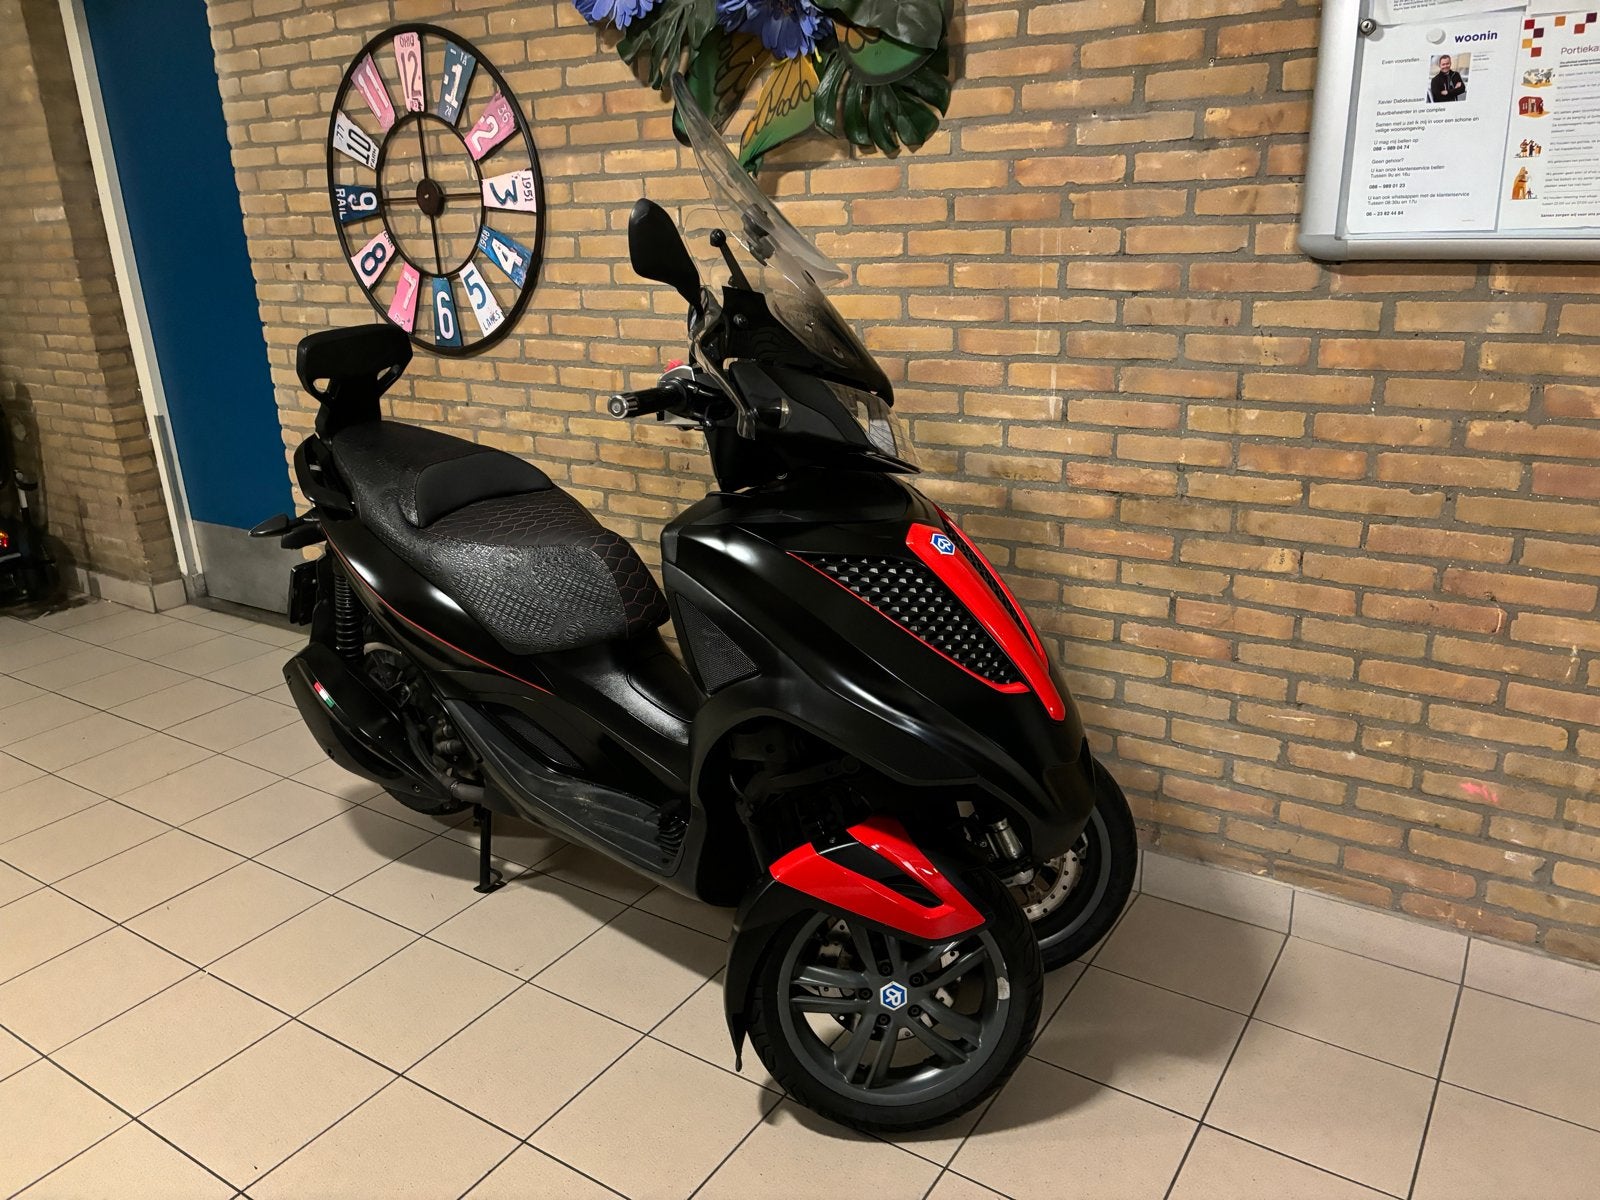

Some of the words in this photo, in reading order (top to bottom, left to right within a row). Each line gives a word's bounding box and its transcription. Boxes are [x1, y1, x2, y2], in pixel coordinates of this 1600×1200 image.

[1455, 30, 1498, 43] woonin
[401, 51, 422, 99] 12
[346, 128, 371, 165] 10
[470, 115, 499, 151] 2
[335, 188, 346, 220] RAIL
[348, 191, 377, 211] 9
[489, 180, 518, 206] 3
[521, 177, 534, 202] 1951
[360, 243, 387, 276] 8
[491, 238, 524, 274] 4
[402, 271, 417, 311] 7
[463, 269, 487, 310] 5
[436, 291, 455, 339] 6
